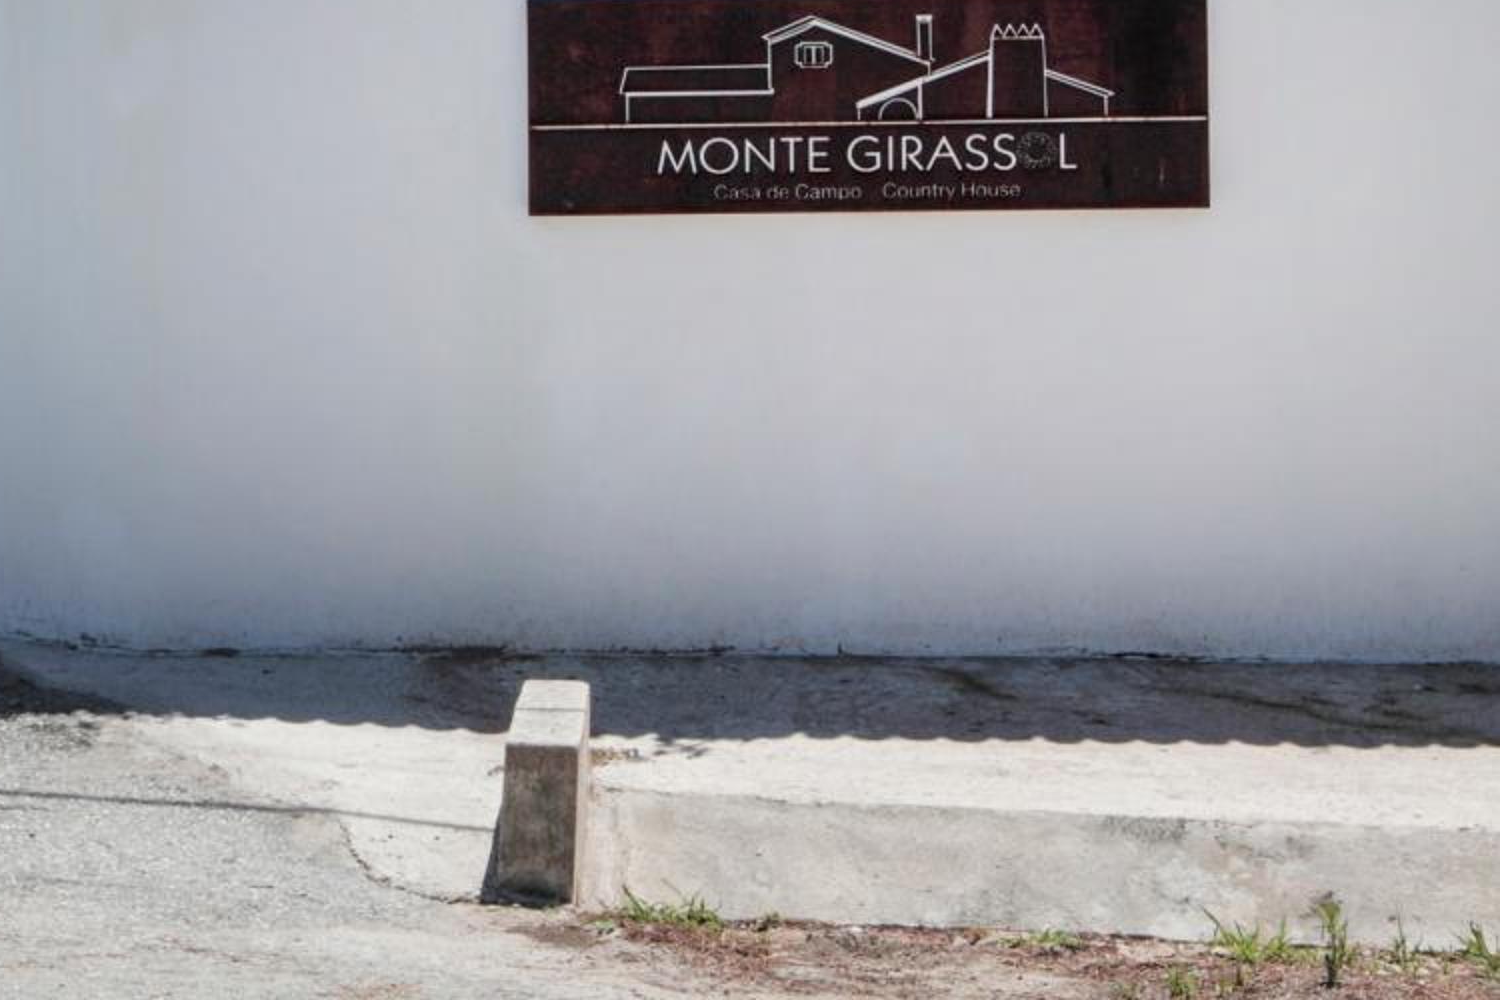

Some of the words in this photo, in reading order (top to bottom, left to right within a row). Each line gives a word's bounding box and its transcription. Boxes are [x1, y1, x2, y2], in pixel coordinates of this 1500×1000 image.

[657, 136, 832, 175] MONTE
[846, 132, 1078, 173] GIRASSOL
[713, 183, 761, 200] Casa
[766, 183, 790, 200] de
[795, 183, 863, 202] Campo
[882, 181, 958, 201] Country
[960, 181, 1021, 199] House
